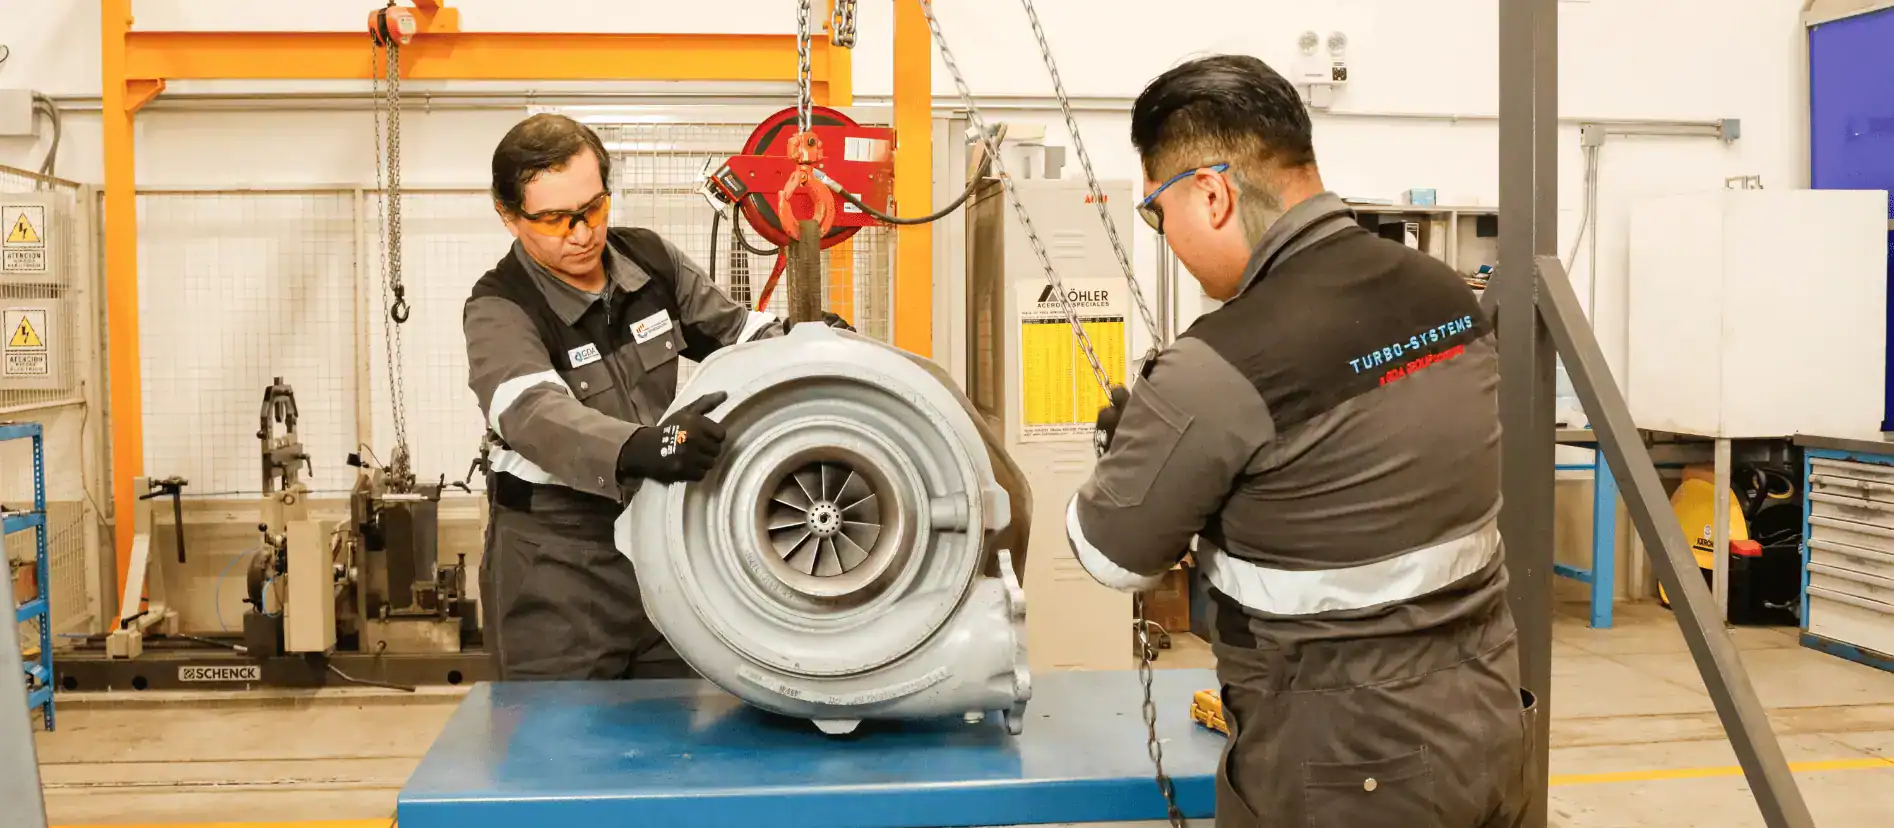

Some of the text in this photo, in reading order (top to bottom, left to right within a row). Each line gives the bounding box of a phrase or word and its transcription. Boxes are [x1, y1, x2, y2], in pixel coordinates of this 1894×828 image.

[1061, 288, 1109, 302] ÖHLER
[1349, 315, 1473, 374] TURBO-SYSTEMS
[196, 668, 255, 679] SCHENCK
